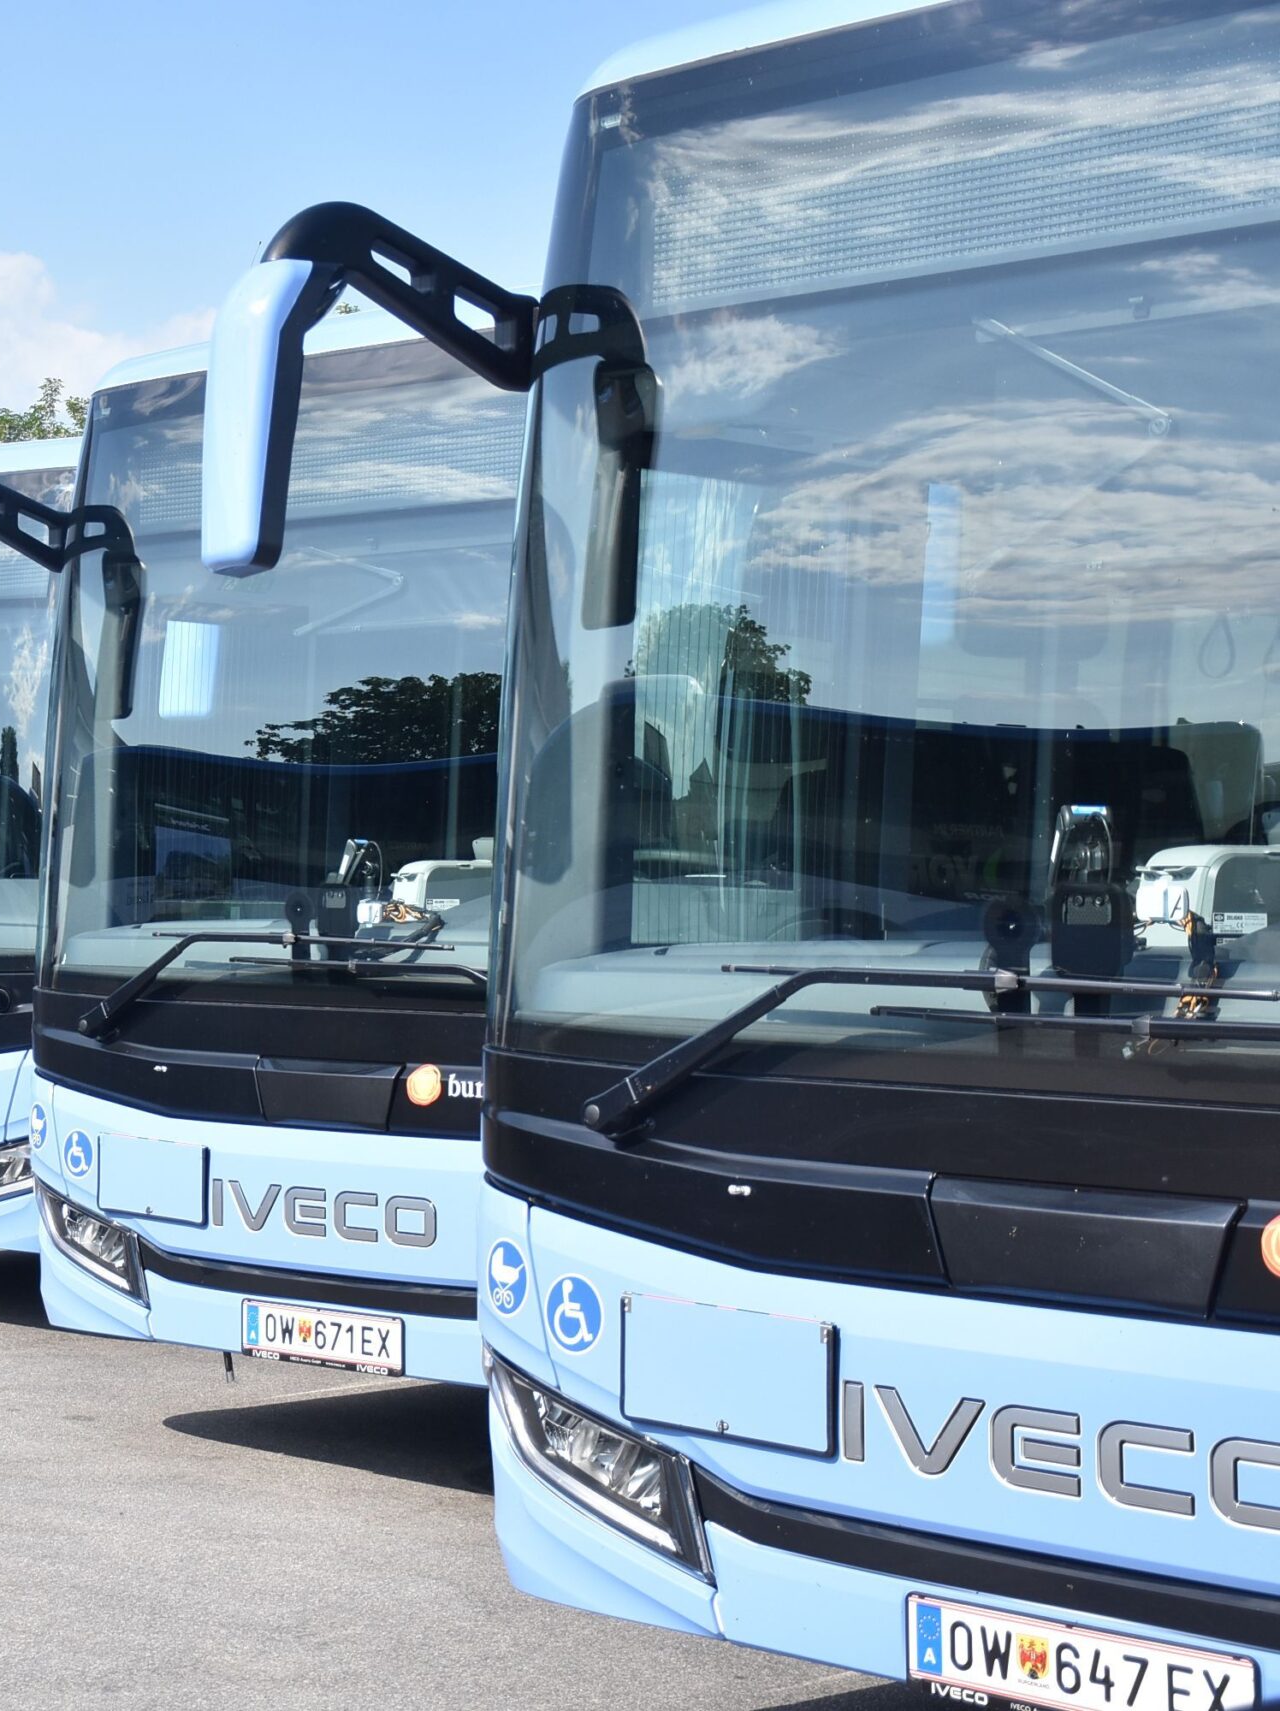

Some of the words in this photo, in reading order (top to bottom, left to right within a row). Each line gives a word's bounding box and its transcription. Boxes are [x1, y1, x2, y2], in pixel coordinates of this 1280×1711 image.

[211, 1178, 438, 1248] IVECO
[265, 1313, 295, 1345] OW
[252, 1349, 280, 1360] IVECO
[356, 1364, 389, 1376] IVECO
[841, 1379, 1280, 1534] IVECO
[950, 1620, 1012, 1681] OW
[930, 1682, 989, 1706] IVECO
